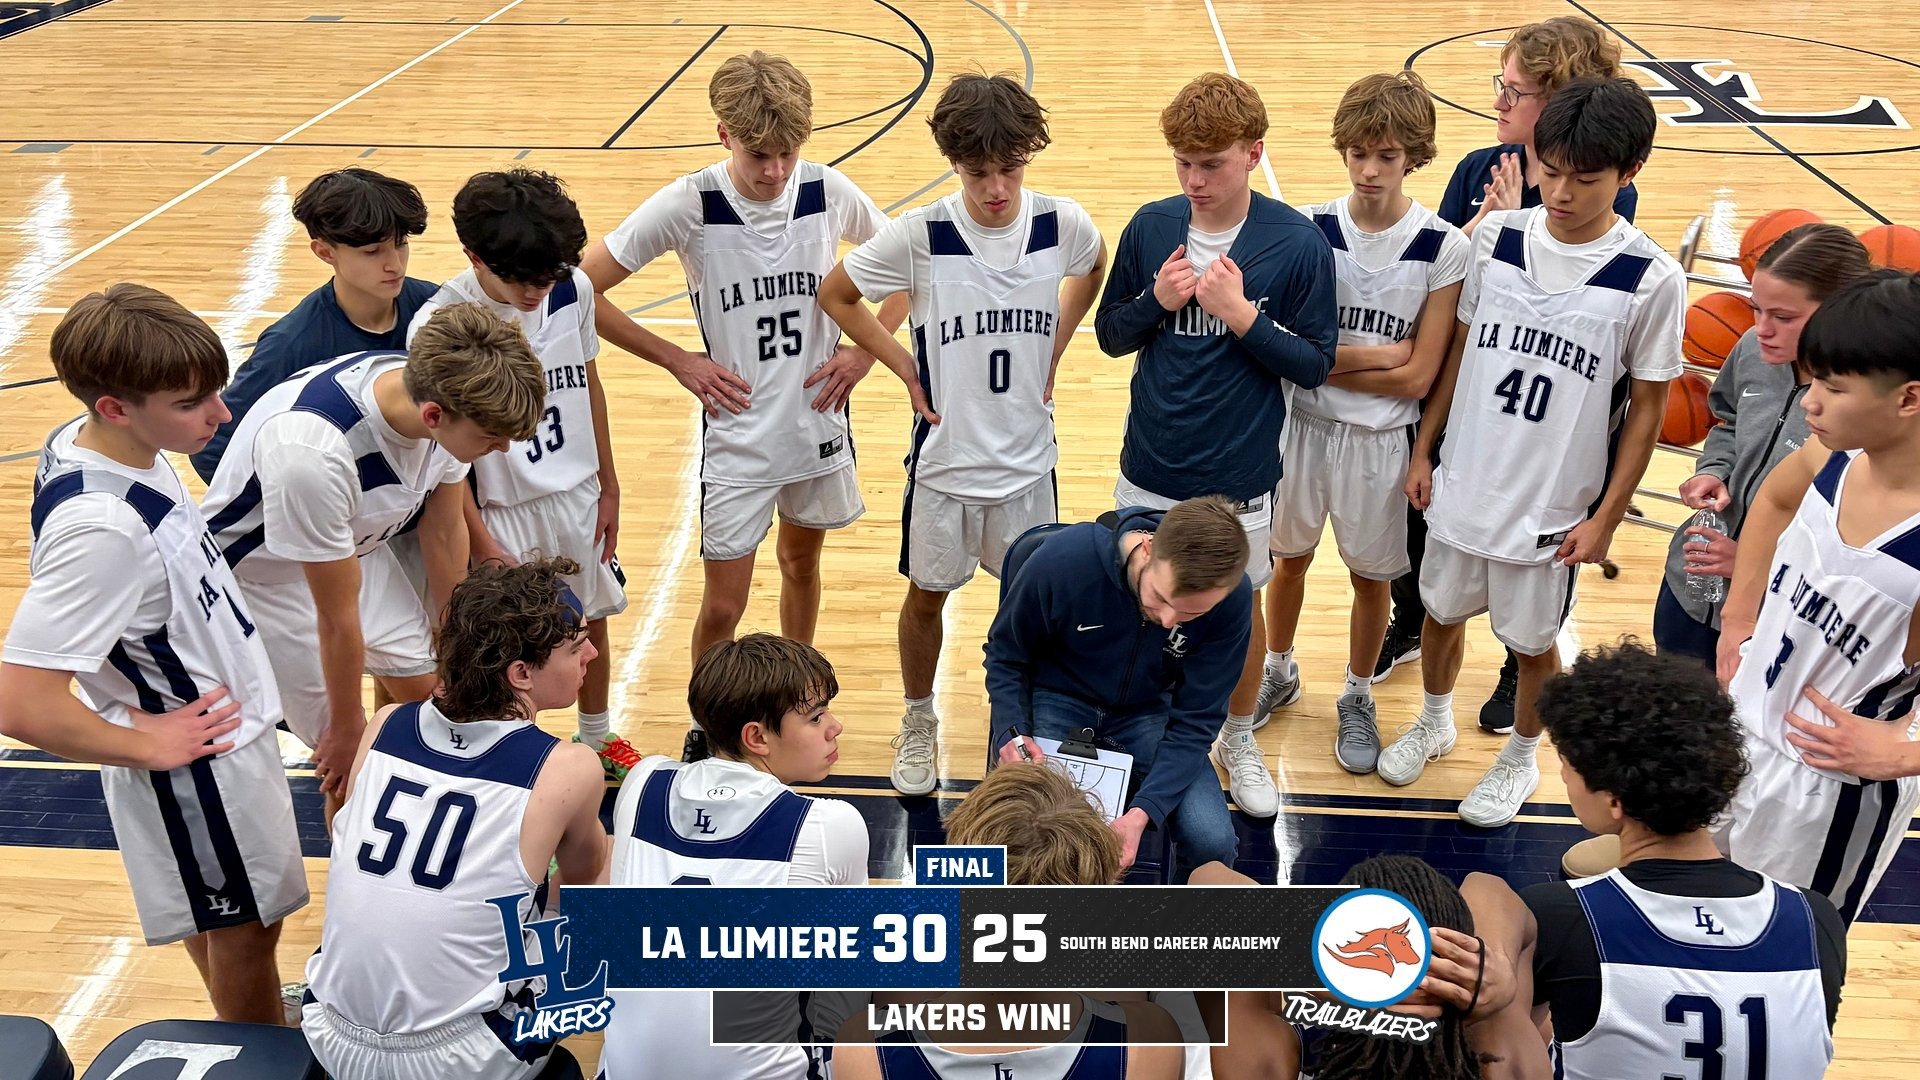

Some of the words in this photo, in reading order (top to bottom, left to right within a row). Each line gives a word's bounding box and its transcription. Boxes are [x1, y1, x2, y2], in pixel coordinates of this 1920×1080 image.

[719, 284, 744, 312] LA
[752, 270, 823, 300] LUMIER
[757, 311, 803, 361] 25
[940, 315, 963, 345] LA
[975, 308, 1052, 337] LUMIERE
[1338, 306, 1413, 343] LUMIER
[989, 349, 1011, 393] 0
[1478, 323, 1500, 348] LA
[1509, 325, 1600, 382] LUMIERE
[543, 365, 587, 392] IERE
[1495, 368, 1553, 424] 40
[1765, 631, 1796, 690] 3
[355, 773, 479, 892] 50
[1661, 991, 1770, 1080] 31
